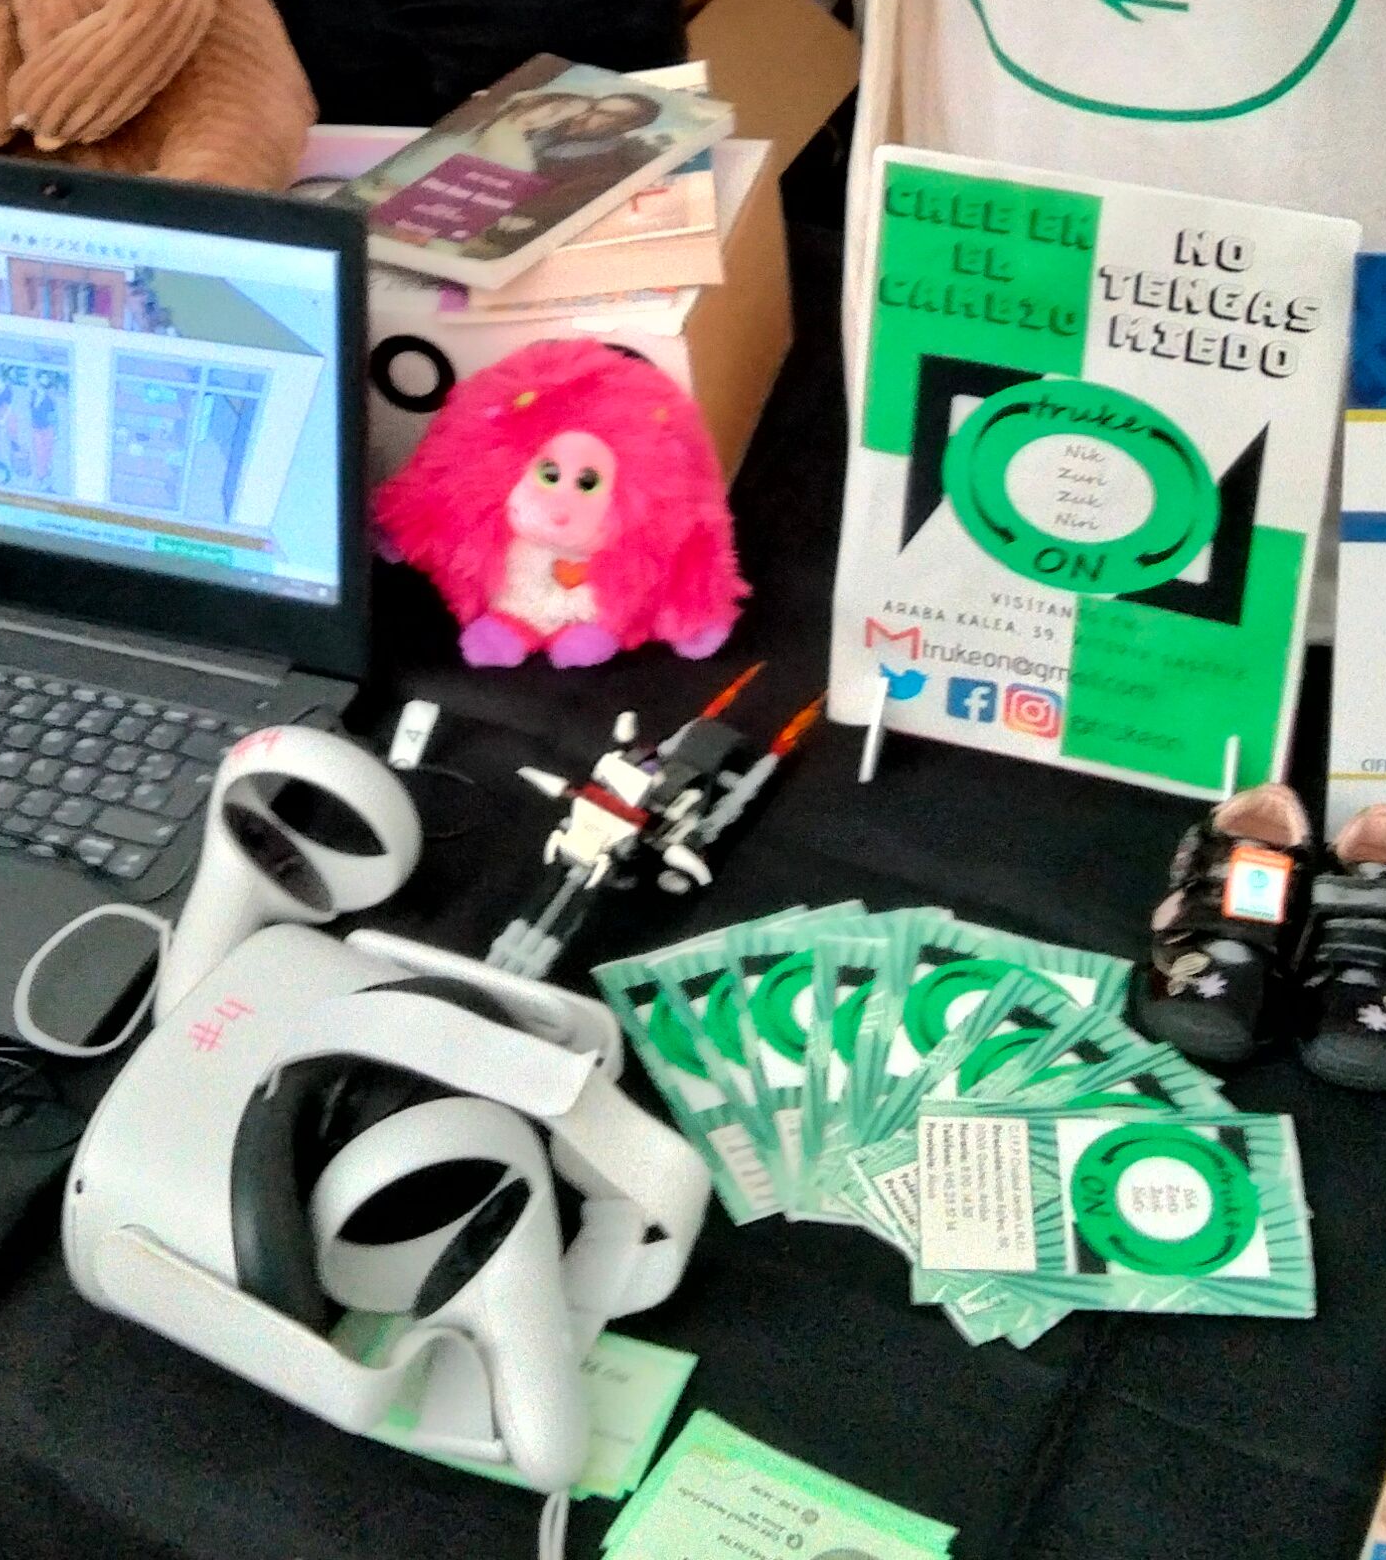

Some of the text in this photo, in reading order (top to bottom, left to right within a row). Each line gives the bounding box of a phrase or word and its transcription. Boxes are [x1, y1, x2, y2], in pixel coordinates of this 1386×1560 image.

[1175, 228, 1256, 272] NO
[1100, 264, 1324, 334] TENGAS
[1108, 314, 1301, 379] MIEDO
[1033, 546, 1107, 583] ON
[882, 599, 945, 623] ARABA
[1080, 1175, 1111, 1217] ON
